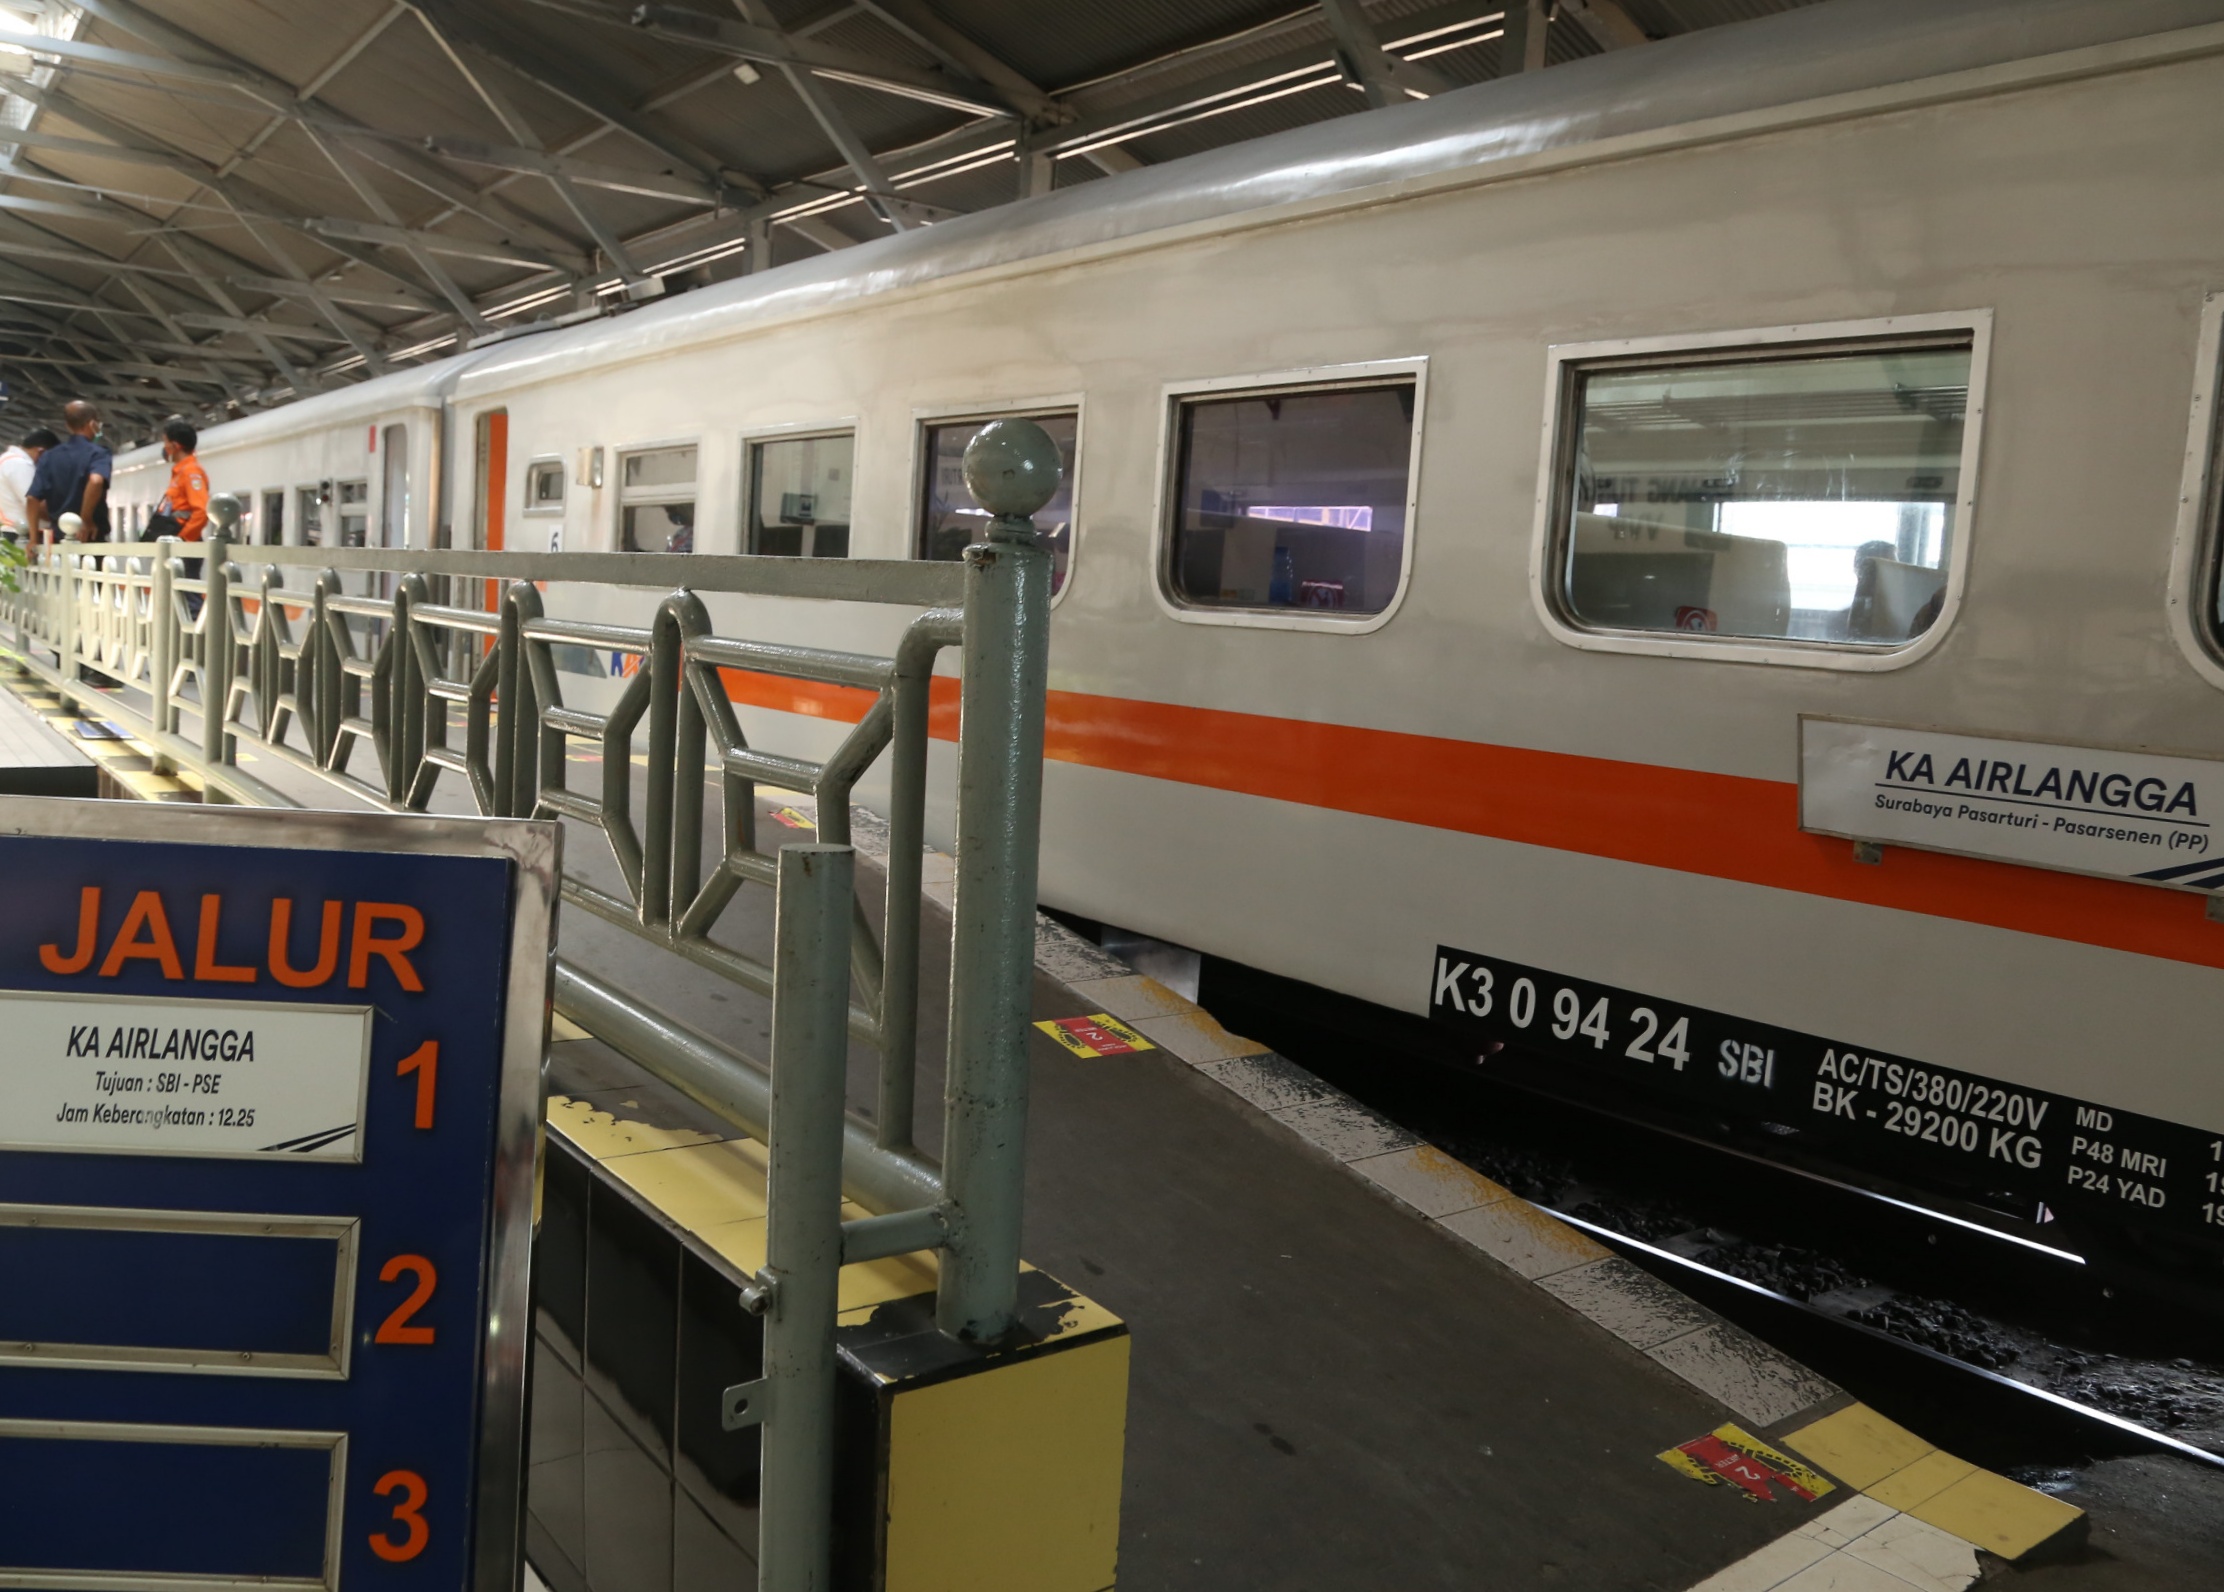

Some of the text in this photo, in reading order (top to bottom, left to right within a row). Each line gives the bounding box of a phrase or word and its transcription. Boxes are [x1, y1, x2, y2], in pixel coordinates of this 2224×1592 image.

[1885, 750, 2197, 816] KA AIRLANGGA
[1875, 795, 1952, 819] Surabaya
[1958, 805, 2038, 829] Pasarturi
[2053, 817, 2162, 846] Pasarsenen
[2168, 830, 2209, 854] (PP)
[38, 886, 425, 992] JALUR
[66, 1026, 254, 1062] KA AIRLANGGA
[1434, 957, 1775, 1088] K3 0 94 24 SBI
[96, 1071, 143, 1096] Tujuan
[156, 1073, 181, 1093] SBI
[192, 1074, 221, 1094] PSE
[396, 1040, 439, 1129] 1
[1817, 1049, 2049, 1131] AC/TS/380/220V
[57, 1103, 88, 1123] Jam
[92, 1103, 205, 1129] Keberangkatan
[218, 1108, 255, 1127] 12.25
[1813, 1081, 1859, 1120] BK
[1884, 1101, 1978, 1152] 29200
[1988, 1127, 2042, 1169] KG
[2076, 1106, 2113, 1132] MD
[2067, 1165, 2166, 1208] P24 YAD
[2072, 1136, 2167, 1178] P48 MRI
[373, 1254, 438, 1344] 2
[1735, 1465, 1760, 1480] 2
[368, 1470, 430, 1562] 3
